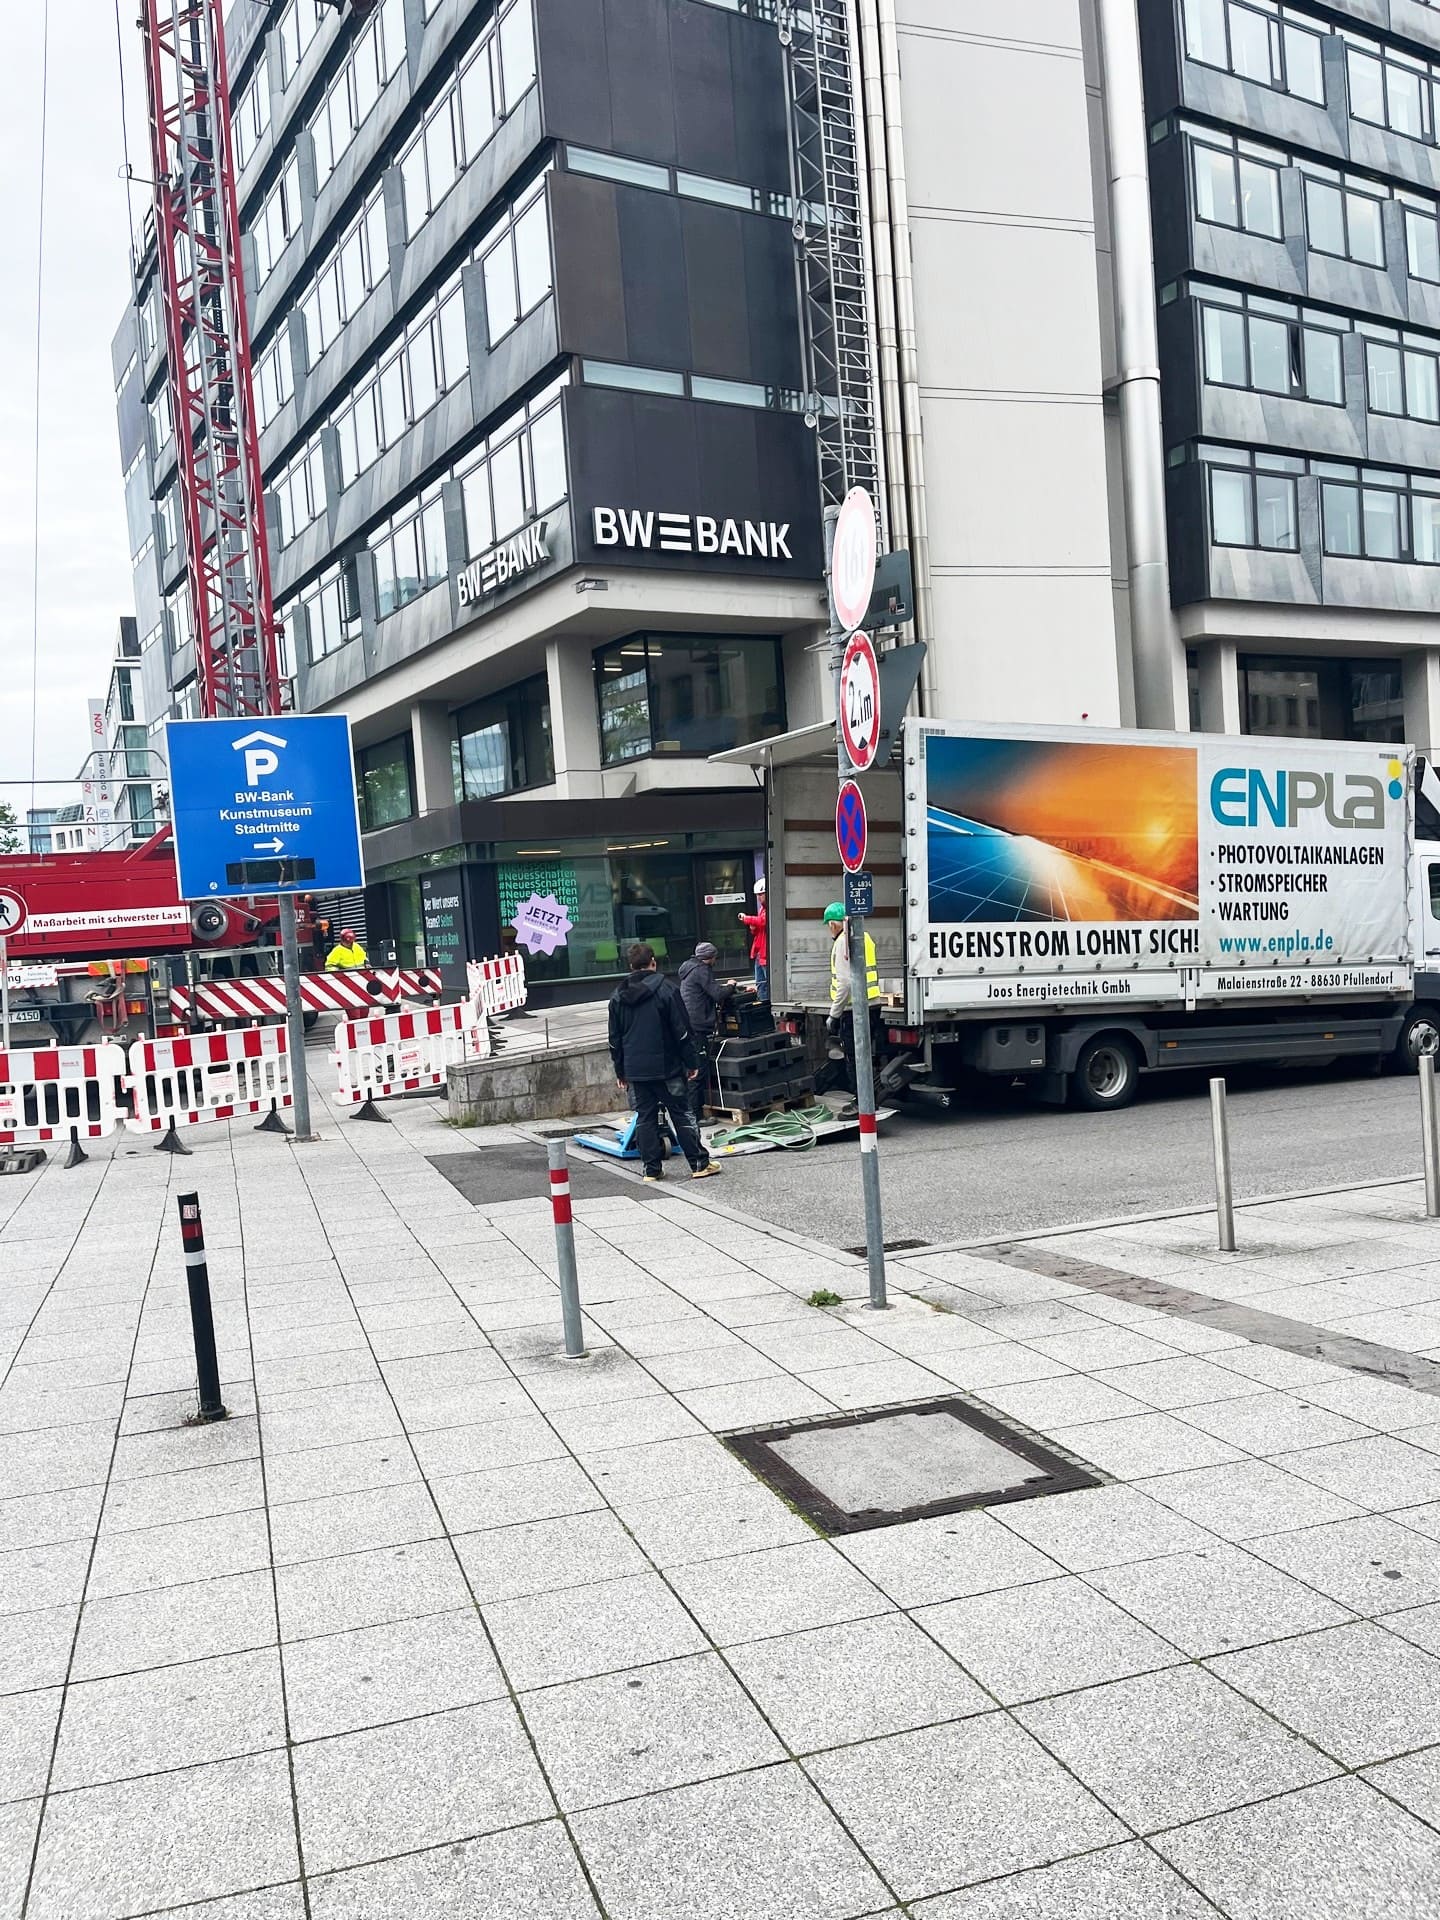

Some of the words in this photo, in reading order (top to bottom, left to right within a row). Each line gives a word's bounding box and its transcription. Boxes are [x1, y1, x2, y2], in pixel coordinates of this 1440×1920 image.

[696, 516, 793, 559] BANK
[496, 522, 551, 585] BANK
[93, 713, 104, 735] AON
[244, 748, 279, 786] P
[235, 790, 295, 804] BW-Bank
[219, 806, 312, 821] Kunstmuseum
[235, 822, 300, 835] Stadtmitte
[1218, 845, 1384, 865] PHOTOVOLTAIKANLAGEN
[498, 870, 576, 881] #NeuesSchaffen
[499, 878, 577, 890] #NeuesSchaffen
[1218, 873, 1328, 893] STROMSPEICHER
[33, 918, 86, 928] Maßarbeit
[88, 917, 105, 925] mit
[107, 913, 160, 923] schwerster
[162, 911, 182, 920] Last
[526, 906, 563, 926] JETZT
[1218, 902, 1289, 921] WARTUNG
[929, 930, 1070, 958] EIGENSTROM
[1076, 929, 1143, 956] LOHNT
[1149, 928, 1200, 954] SICH!
[1219, 928, 1334, 957] www.enpla.de
[987, 983, 1013, 999] Joos
[1016, 980, 1099, 1000] Energietechnik
[1102, 979, 1131, 995] Gmbh
[1218, 976, 1287, 991] Malaienstraße
[1290, 975, 1302, 988] 22
[1311, 974, 1341, 987] 88630
[1343, 971, 1393, 986] Pfullendorf
